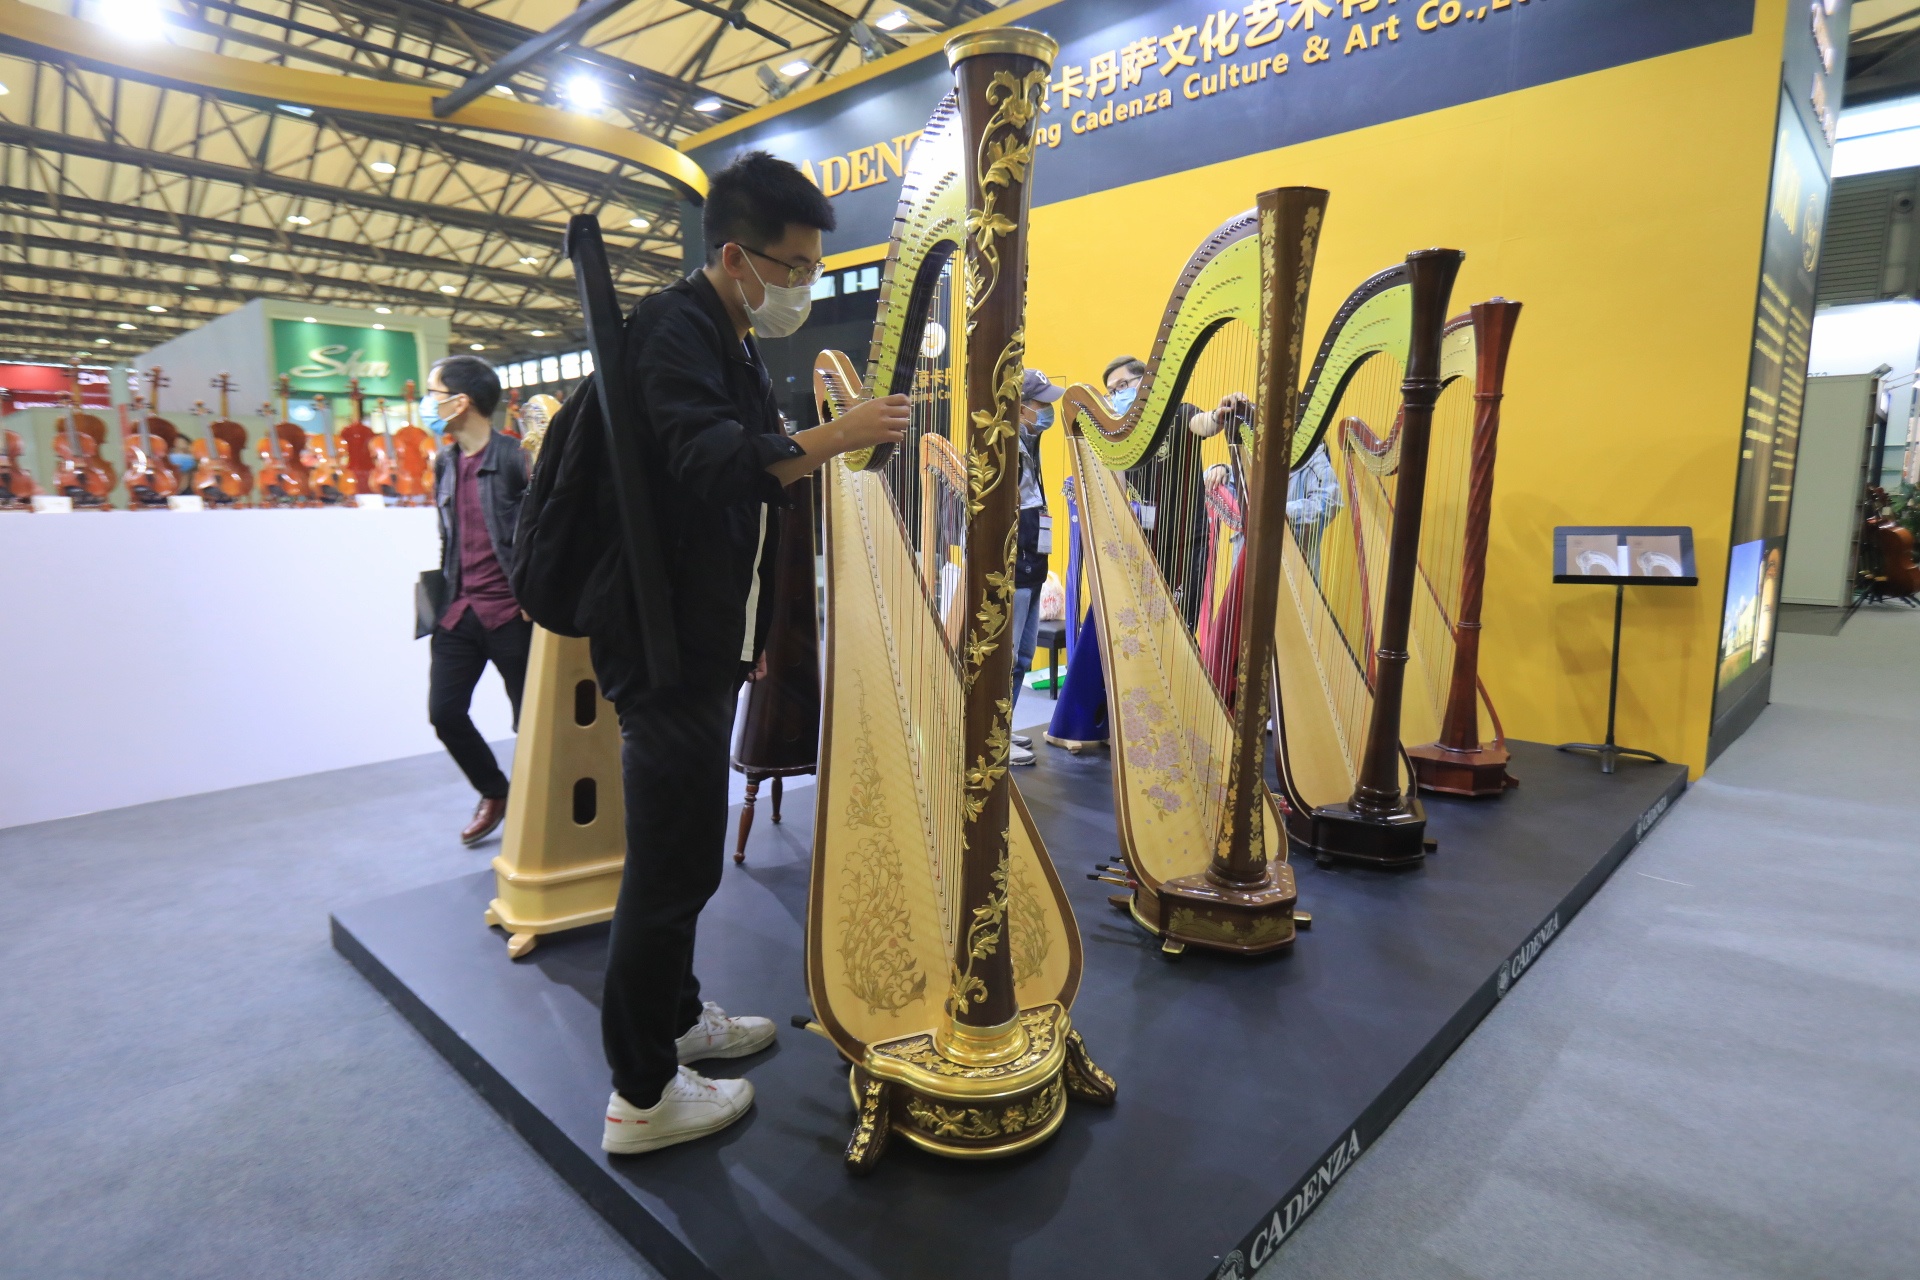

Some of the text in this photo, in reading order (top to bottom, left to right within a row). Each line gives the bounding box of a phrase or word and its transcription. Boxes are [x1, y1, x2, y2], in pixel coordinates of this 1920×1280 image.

[1071, 88, 1172, 134] Cadenza
[1183, 53, 1289, 100] Culture
[1303, 35, 1330, 64] &
[1343, 14, 1400, 55] Art
[1511, 911, 1559, 979] CADENZA
[1250, 1128, 1361, 1270] CADENZA
